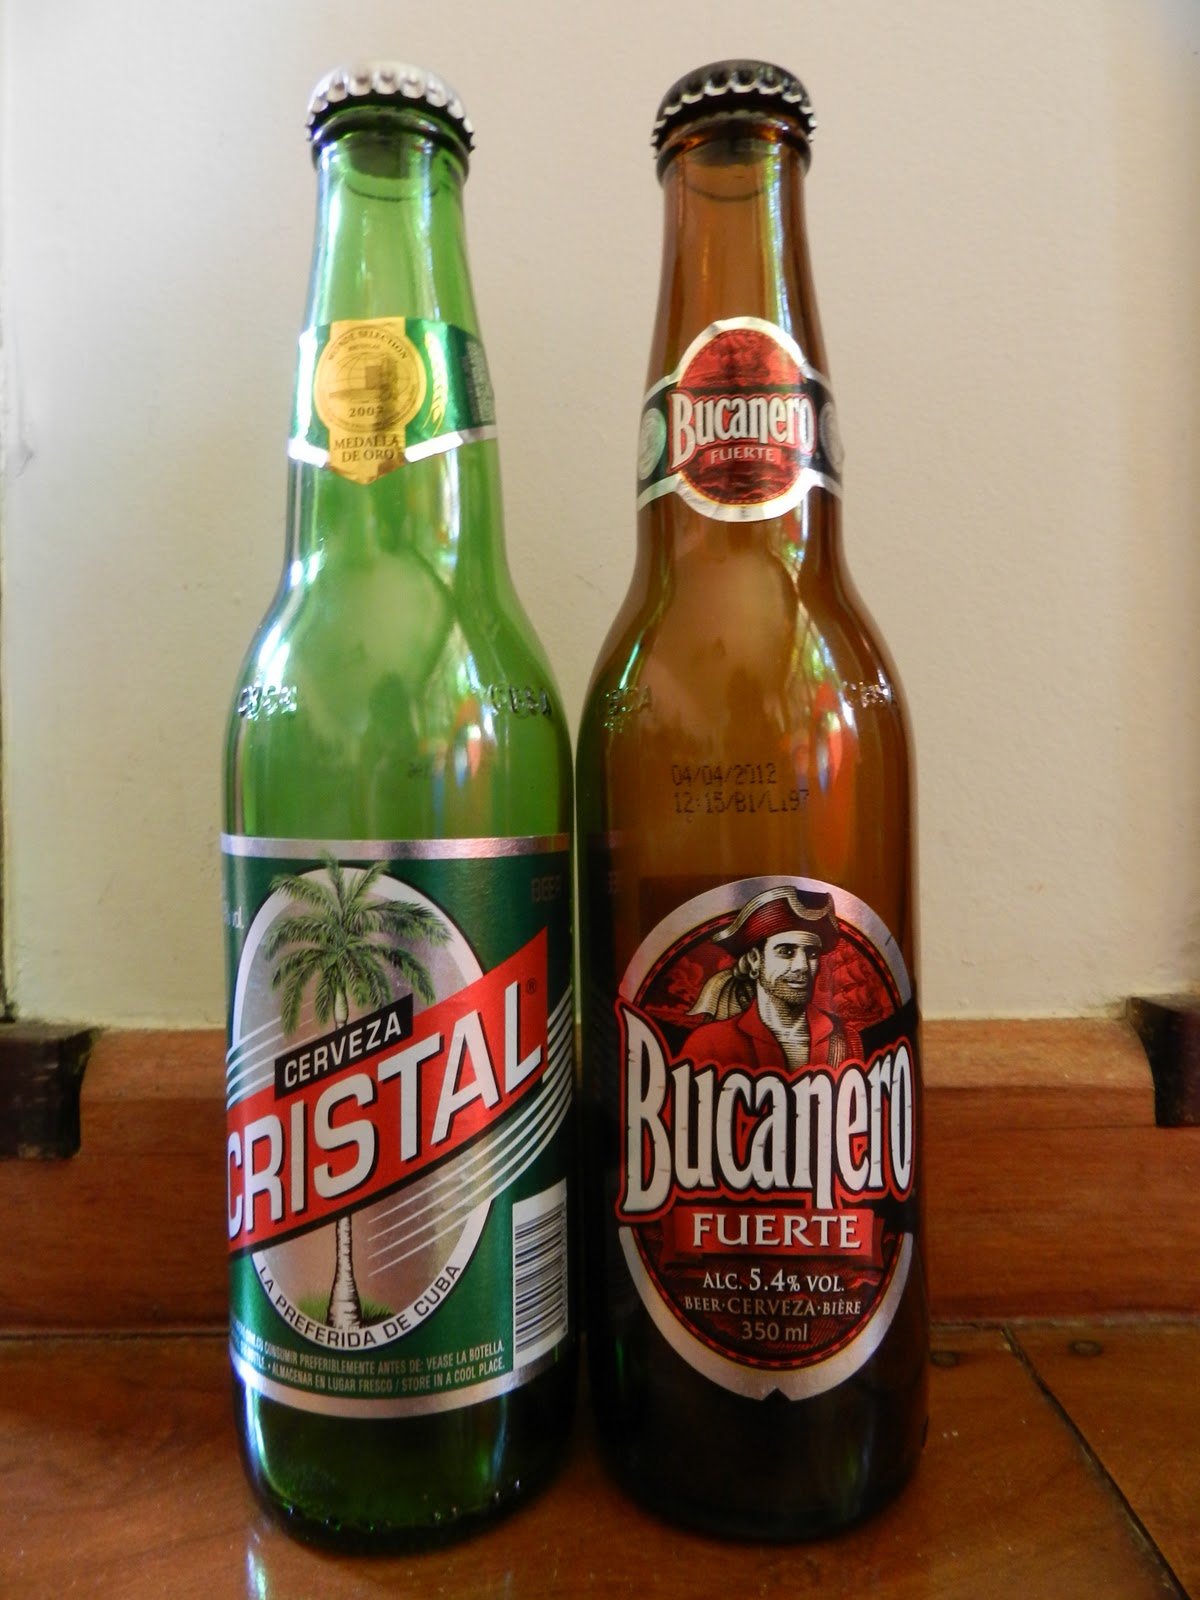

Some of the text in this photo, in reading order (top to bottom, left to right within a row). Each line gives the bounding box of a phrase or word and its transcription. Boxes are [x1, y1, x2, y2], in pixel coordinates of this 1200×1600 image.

[334, 433, 399, 450] MEDALLA
[670, 392, 815, 469] Bucanero
[342, 449, 395, 463] DE ORO
[710, 447, 776, 464] FUERTE
[671, 762, 777, 786] 04/04/2012
[284, 1010, 402, 1088] CERVEZA
[227, 980, 542, 1240] CRISTAL
[622, 1006, 912, 1211] Bucanero
[692, 1213, 862, 1249] FUERTE
[703, 1267, 845, 1293] ALC. 5.4% VOL.
[258, 1266, 274, 1294] LA
[275, 1294, 377, 1348] PREFERIDA
[383, 1316, 412, 1339] DE
[413, 1264, 461, 1316] CUBA
[741, 1321, 809, 1342] 350 ml
[300, 1353, 376, 1375] PREFERIBLEMENTE
[378, 1359, 407, 1375] ANTES
[426, 1353, 454, 1371] VEASE
[456, 1350, 468, 1366] LA
[469, 1339, 505, 1362] BOTELLA.
[315, 1374, 326, 1390] EN
[328, 1375, 356, 1393] LUGAR
[358, 1377, 393, 1393] FRESCO
[402, 1374, 430, 1393] STORE
[433, 1373, 443, 1388] IN
[445, 1371, 452, 1386] A
[454, 1365, 477, 1384] COOL
[479, 1356, 506, 1378] PLACE.
